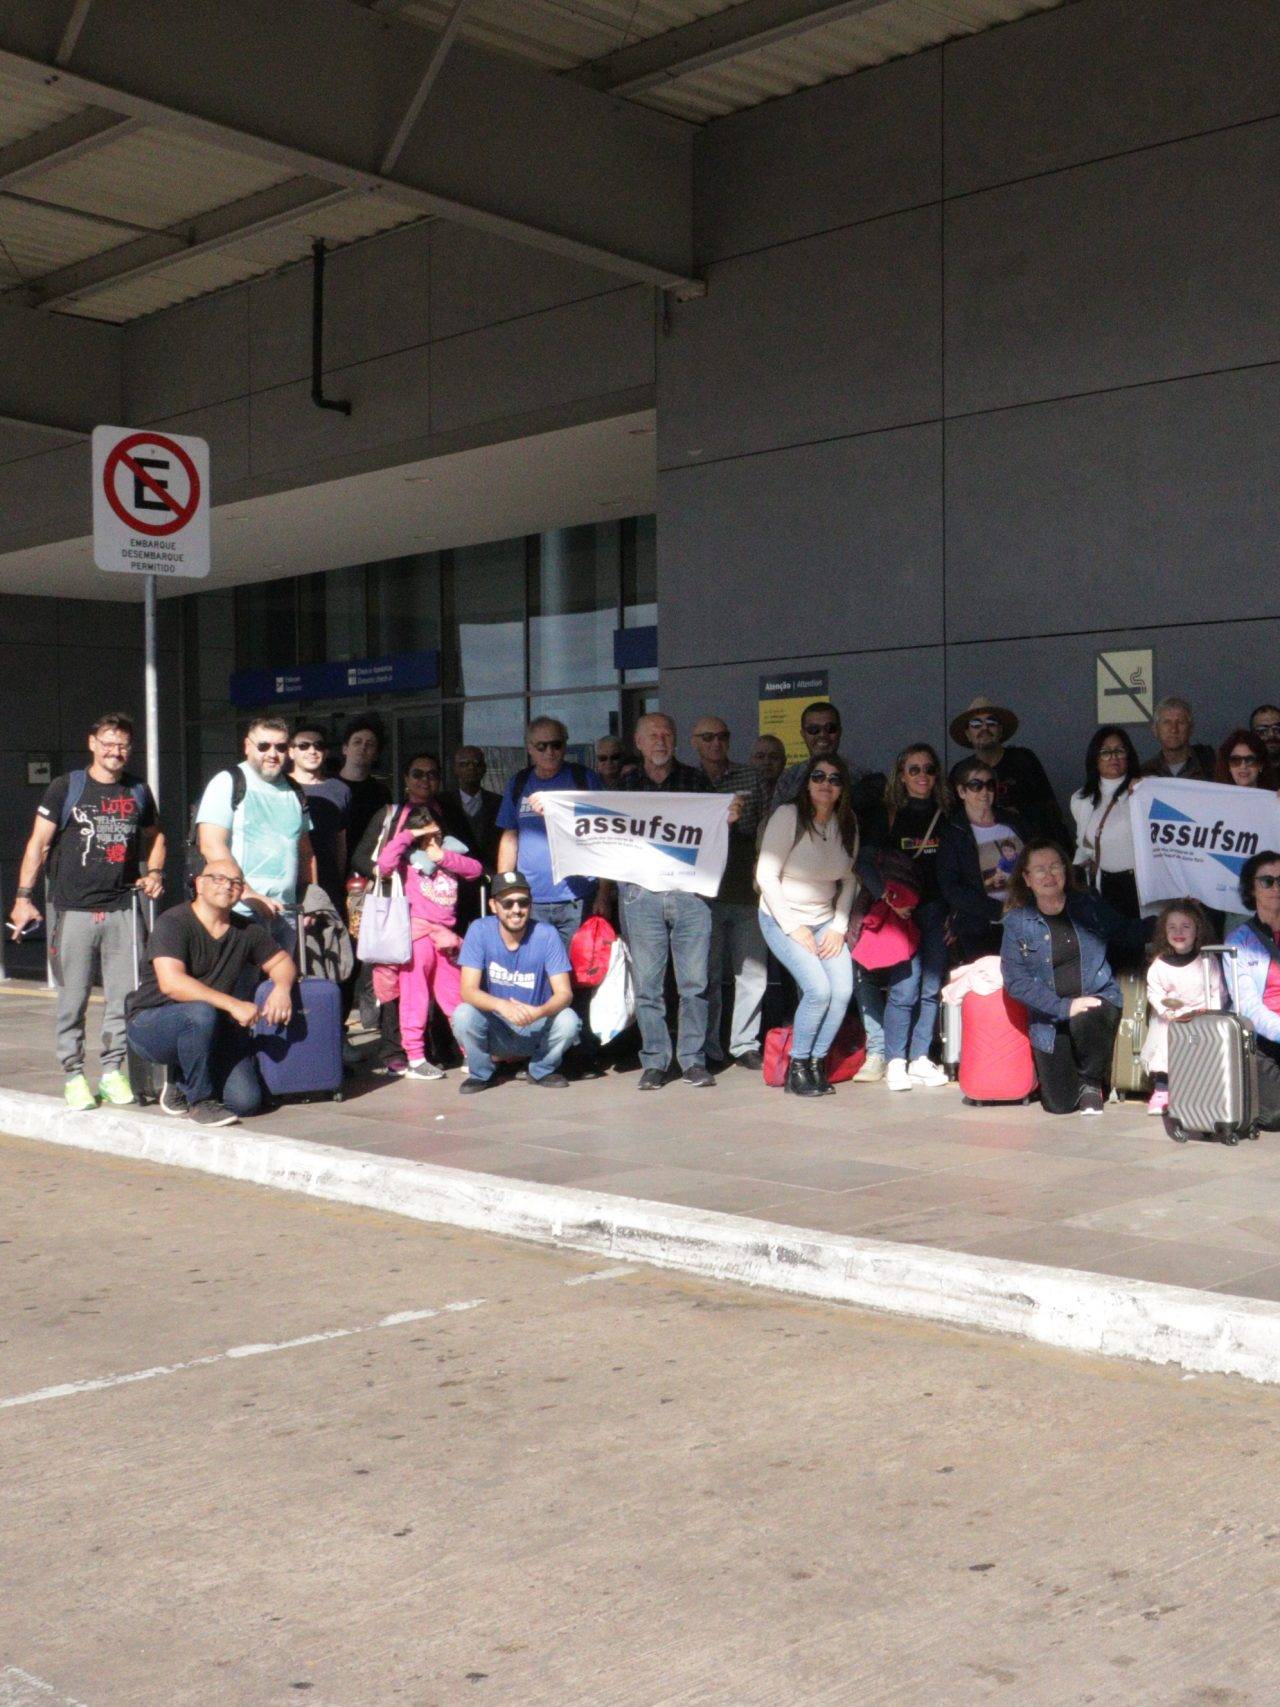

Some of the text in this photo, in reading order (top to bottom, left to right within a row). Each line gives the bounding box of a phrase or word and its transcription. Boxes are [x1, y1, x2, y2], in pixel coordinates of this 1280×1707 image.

[134, 457, 171, 512] E
[130, 539, 176, 551] EMBARQUE
[121, 549, 184, 562] DESEMBARQUE
[131, 562, 175, 573] PERMITIDO
[765, 681, 791, 692] Atenção
[574, 815, 704, 846] assufsm
[1150, 820, 1259, 855] assufsm
